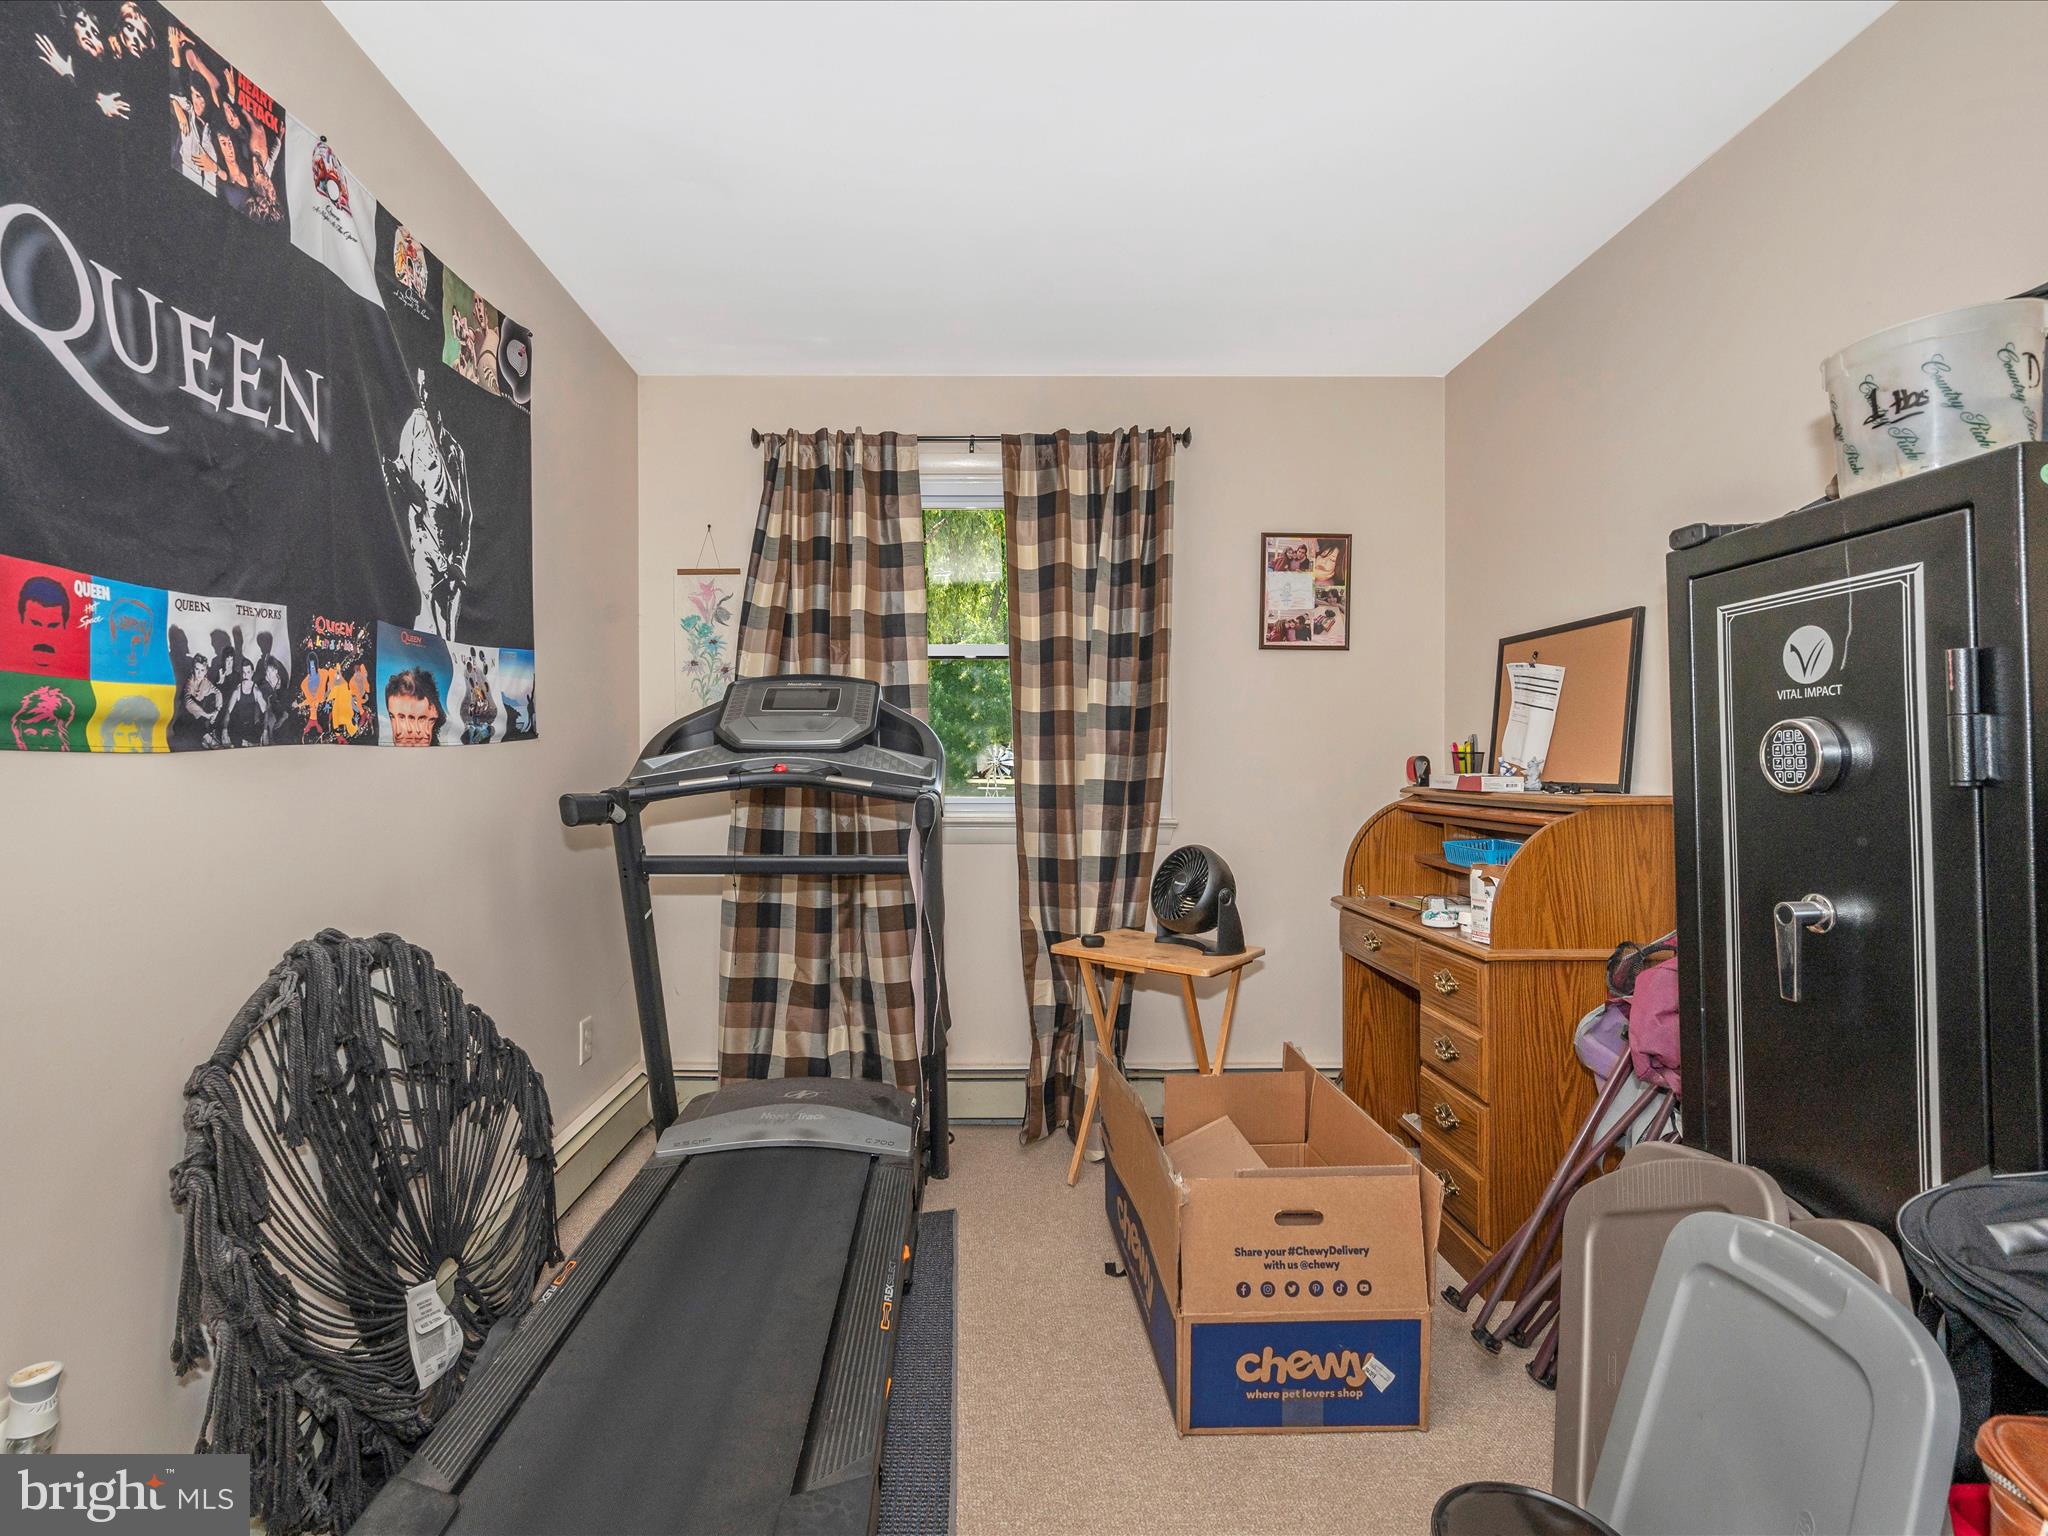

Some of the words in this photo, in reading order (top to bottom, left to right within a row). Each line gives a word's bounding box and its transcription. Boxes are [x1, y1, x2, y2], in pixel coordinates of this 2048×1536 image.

[238, 72, 273, 112] HEART
[238, 90, 278, 133] ATTACK
[0, 203, 324, 444] QUEEN
[1921, 353, 1964, 409] Country
[1960, 411, 1997, 448] Rich
[1997, 342, 2026, 404] Country
[2023, 406, 2038, 442] Ric
[1888, 427, 1926, 461] Rich
[74, 580, 111, 600] QUEEN
[84, 601, 101, 613] Hot
[174, 598, 211, 613] QUEEN
[235, 604, 255, 617] THE
[254, 607, 282, 620] WORKS
[77, 615, 104, 629] Space
[314, 615, 354, 637] QUEEN
[1776, 688, 1803, 701] VITAL
[1804, 683, 1843, 698] IMPACT
[1234, 1246, 1263, 1257] Share
[1265, 1249, 1287, 1259] your
[1288, 1245, 1370, 1259] #ChewyDelivery
[1264, 1260, 1286, 1270] with
[1287, 1262, 1299, 1270] us
[1300, 1260, 1341, 1272] @chewy
[1236, 1346, 1375, 1387] chewy
[1246, 1389, 1280, 1399] where
[1282, 1388, 1300, 1401] pet
[1302, 1388, 1336, 1399] lovers
[1337, 1387, 1364, 1400] shop
